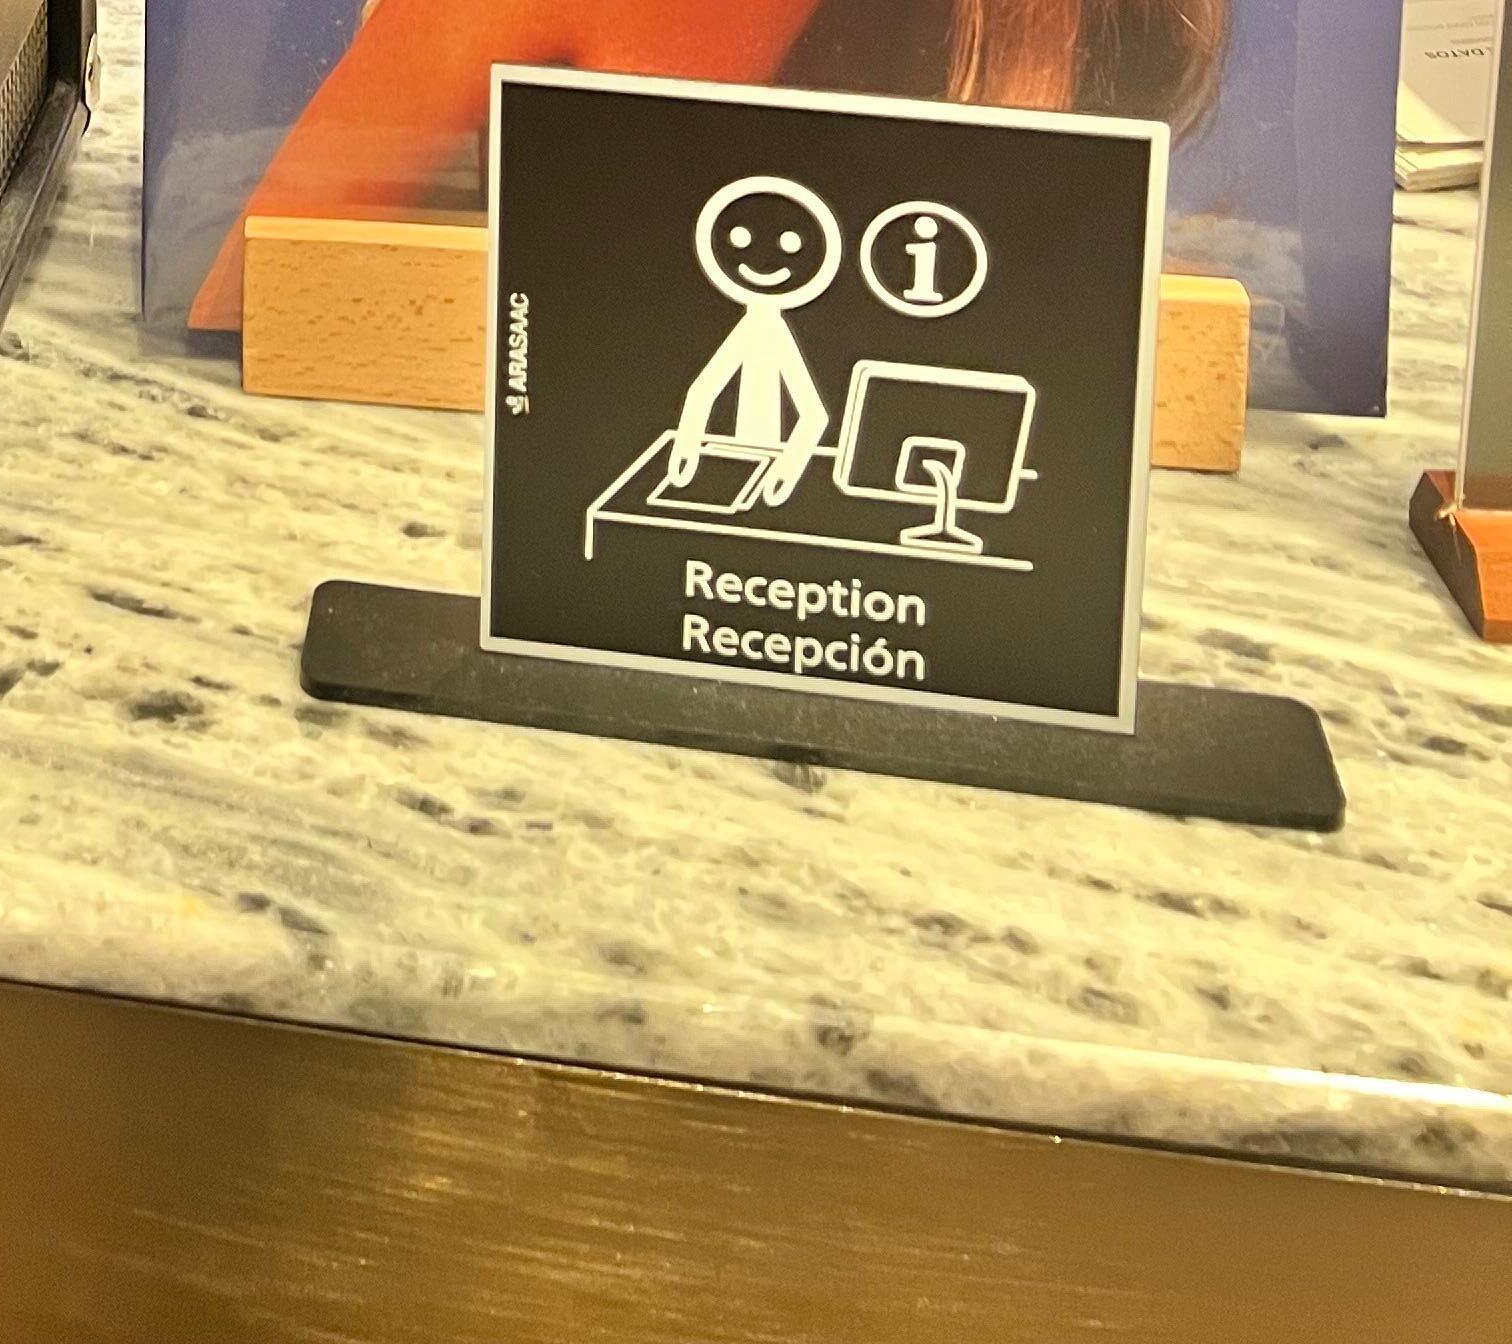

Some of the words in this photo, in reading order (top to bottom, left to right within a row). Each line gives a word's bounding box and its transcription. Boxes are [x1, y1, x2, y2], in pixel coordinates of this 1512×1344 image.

[508, 292, 529, 392] ARASAAC
[684, 558, 927, 627] Reception
[681, 613, 927, 681] Recepción
